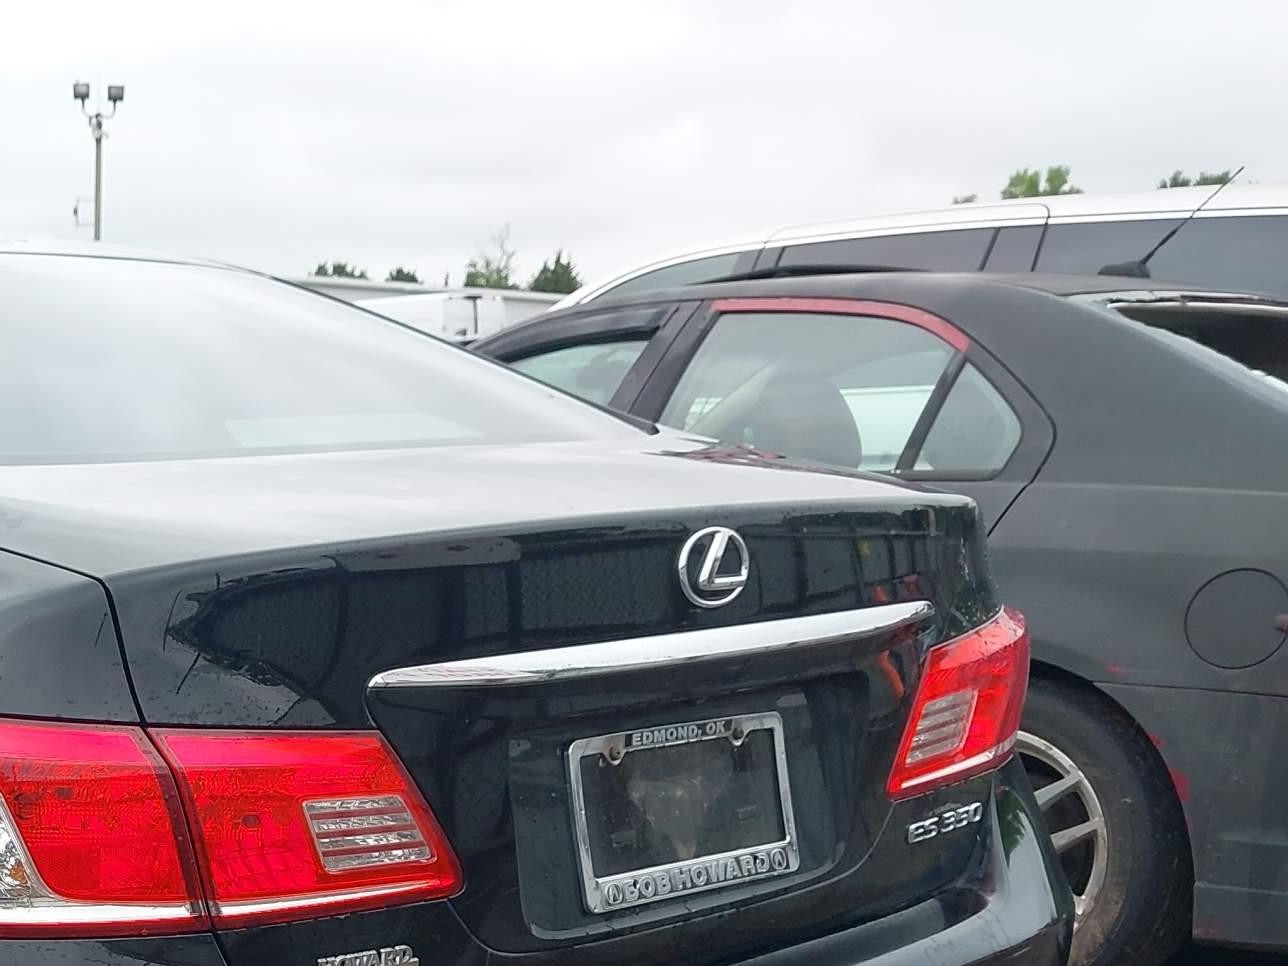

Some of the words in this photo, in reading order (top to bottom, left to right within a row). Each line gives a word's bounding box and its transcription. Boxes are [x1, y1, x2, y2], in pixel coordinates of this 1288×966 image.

[632, 725, 702, 746] EDMOND,
[705, 720, 726, 735] OK
[908, 817, 938, 844] ES
[941, 802, 983, 833] 350
[623, 873, 671, 901] BOB
[675, 854, 770, 889] HOWARD
